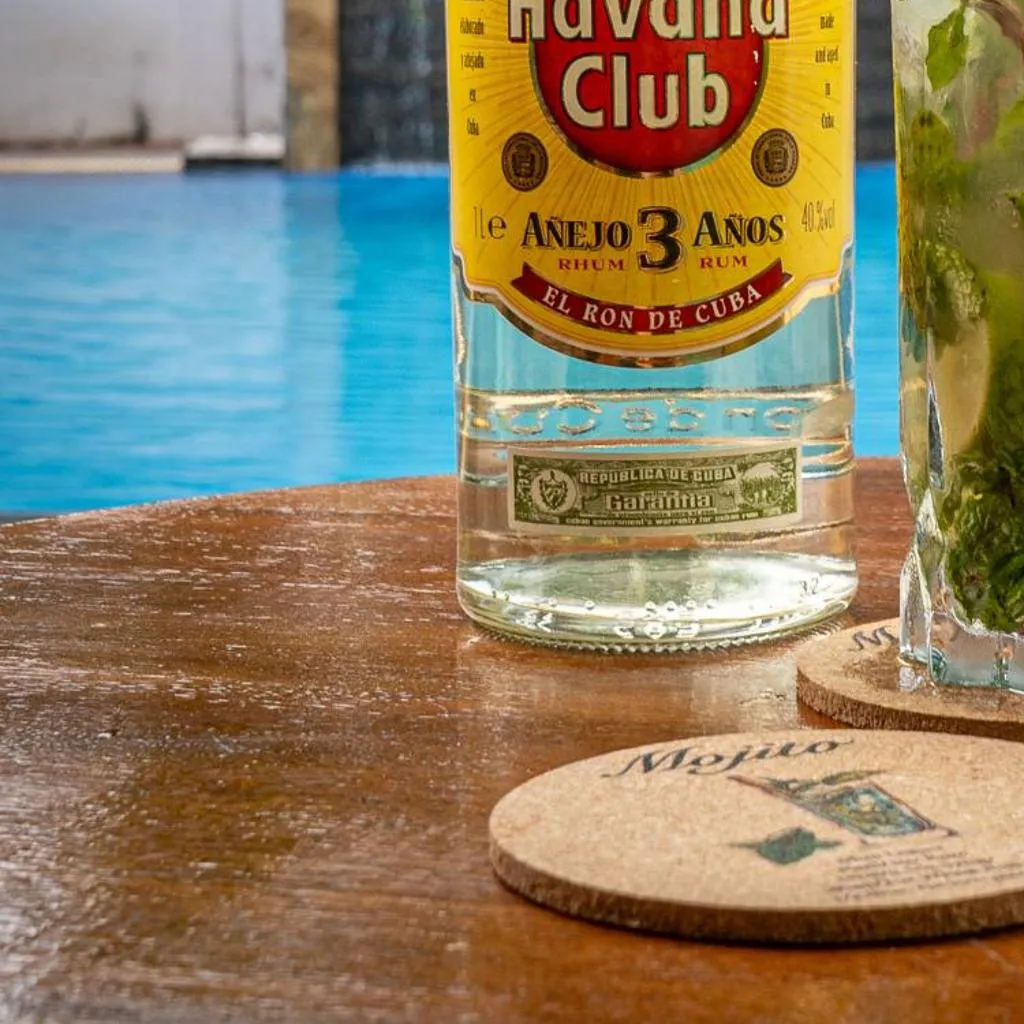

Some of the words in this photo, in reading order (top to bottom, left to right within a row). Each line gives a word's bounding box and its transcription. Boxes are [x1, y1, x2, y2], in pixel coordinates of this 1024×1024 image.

[560, 50, 730, 130] Club
[520, 211, 632, 251] AÑEJO
[637, 205, 682, 273] 3
[692, 210, 785, 249] AÑOS
[558, 258, 625, 272] RHUM
[699, 255, 749, 269] RUM
[542, 286, 572, 313] EL
[583, 307, 634, 330] RON
[649, 312, 684, 330] DE
[695, 287, 763, 323] CUBA
[693, 466, 737, 482] CUBA
[601, 737, 855, 778] Mojito
